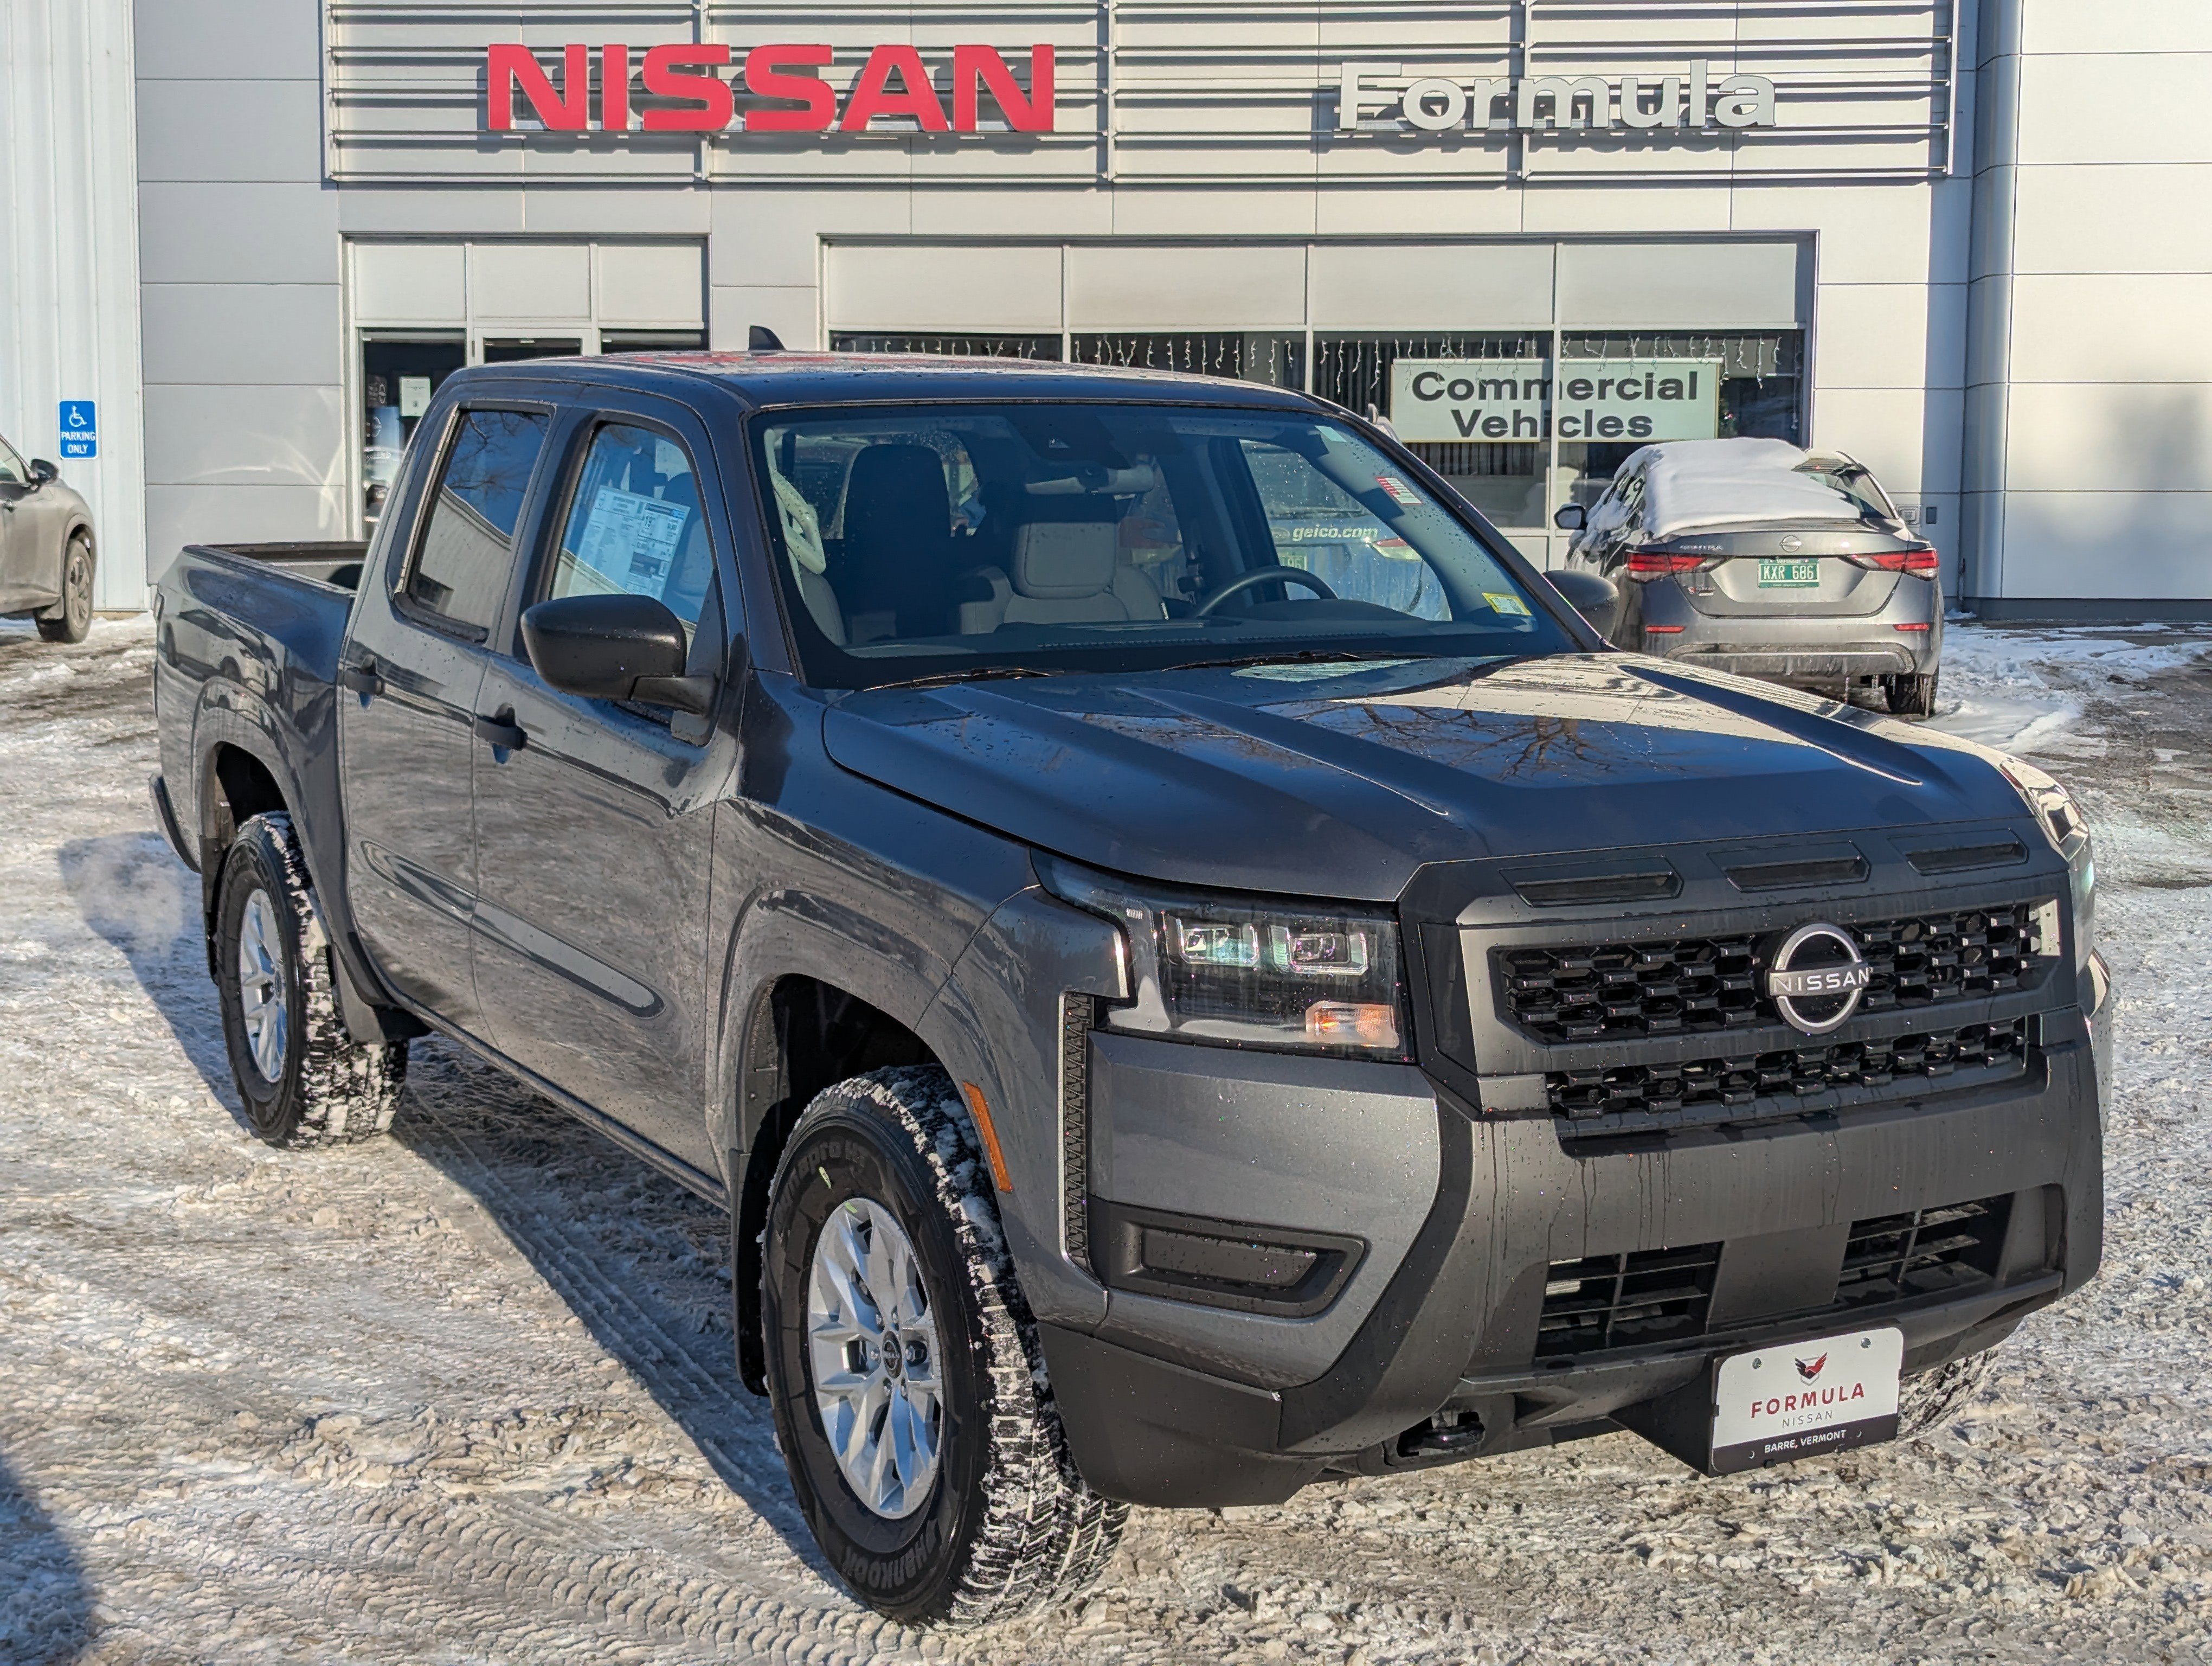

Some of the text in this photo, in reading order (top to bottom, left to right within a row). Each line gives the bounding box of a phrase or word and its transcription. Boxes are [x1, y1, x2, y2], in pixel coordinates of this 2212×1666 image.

[487, 43, 1056, 132] NISSAN
[1339, 59, 1776, 130] Formula
[1411, 371, 1698, 401] Commercial
[1450, 408, 1654, 438] Vehicles
[61, 431, 96, 441] PARKING
[67, 444, 88, 454] ONLY
[1292, 524, 1378, 542] geico.com
[1764, 566, 1814, 580] KXR 686
[1773, 967, 1869, 992] NISSAN
[1750, 1382, 1865, 1419] FORMULA
[1782, 1410, 1833, 1428] NISSAN
[1764, 1430, 1847, 1454] BARRE, VERMONT
